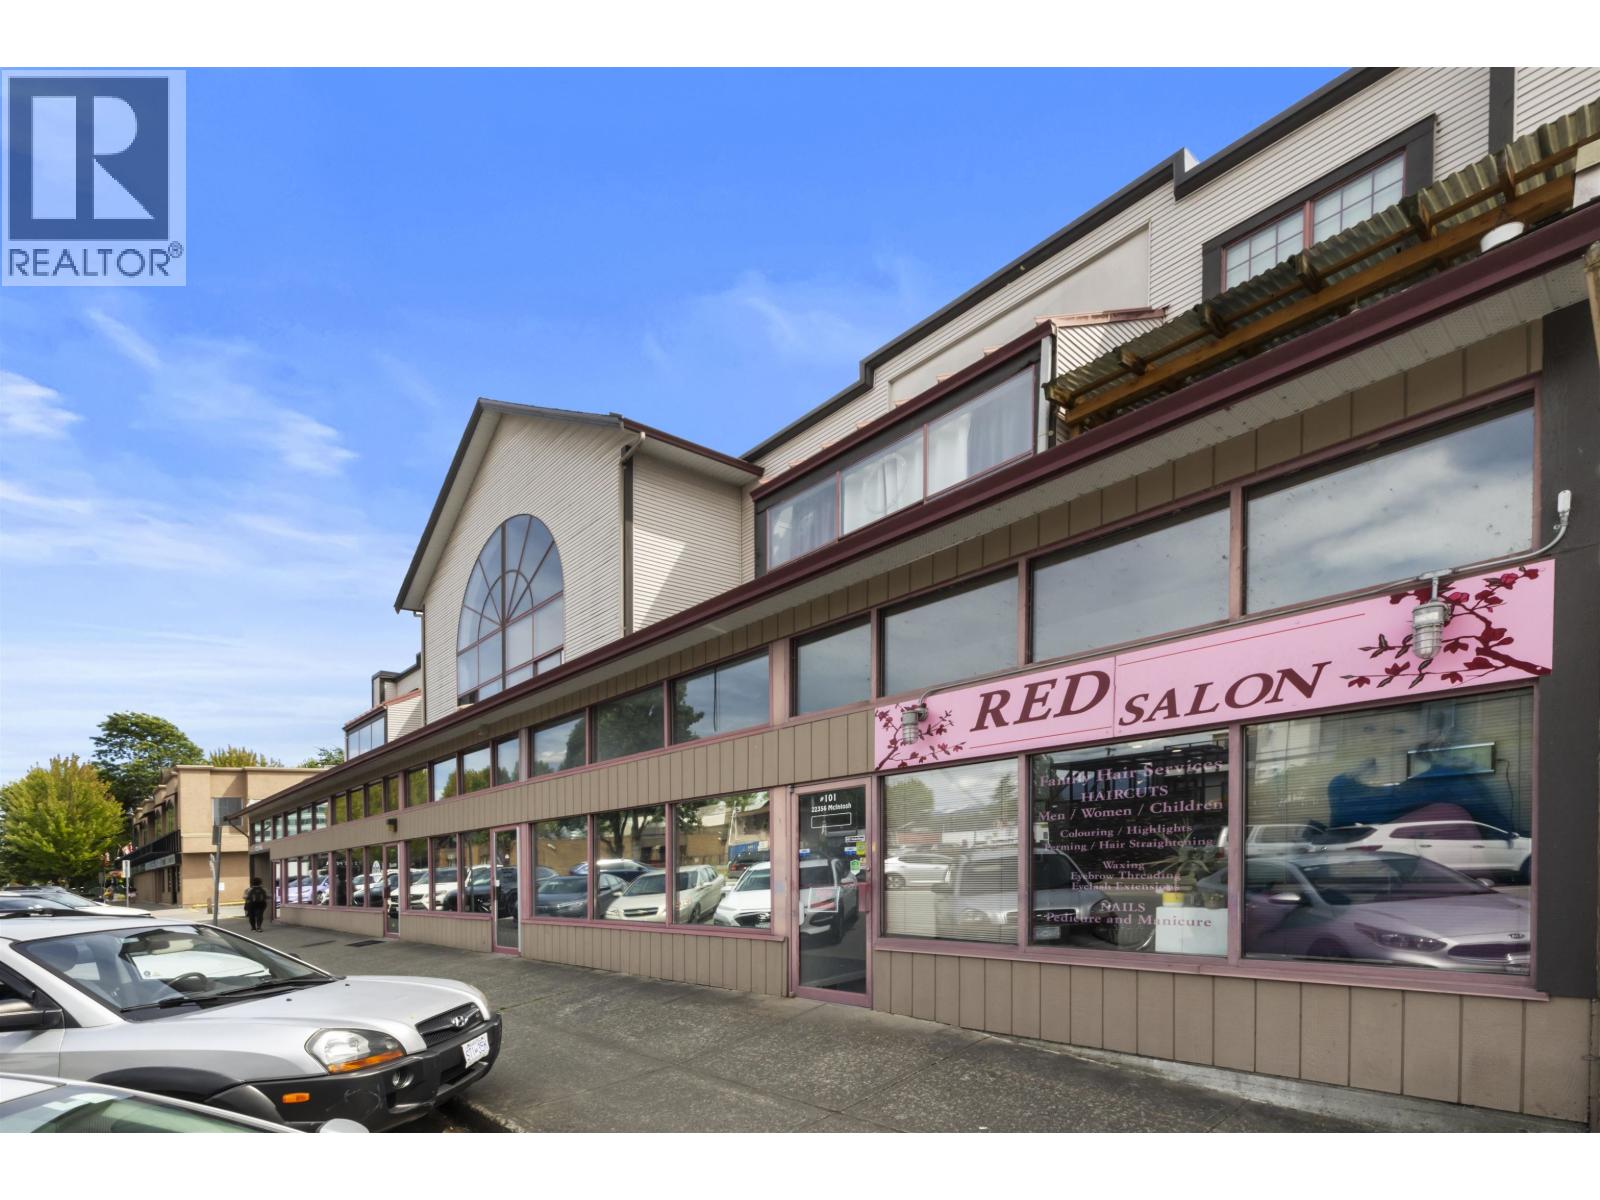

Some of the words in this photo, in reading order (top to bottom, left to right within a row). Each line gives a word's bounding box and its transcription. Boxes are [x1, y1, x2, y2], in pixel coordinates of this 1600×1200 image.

[970, 670, 1111, 732] RED
[1119, 661, 1332, 726] SALON
[1096, 766, 1136, 783] Hair
[1143, 759, 1224, 778] Services
[1081, 785, 1169, 803] HAIRCUTS
[1039, 810, 1066, 822] Men
[1081, 807, 1133, 819] Women
[1149, 799, 1224, 814] Children
[1060, 828, 1114, 838] Colouring
[1126, 823, 1193, 836] Highlights
[1044, 842, 1088, 852] Perming
[1099, 840, 1126, 850] Hair
[1128, 836, 1215, 849] Straightening
[1102, 860, 1146, 870] Waxing
[1070, 871, 1114, 882] Eyebrow
[1118, 870, 1182, 881] Threading
[1100, 902, 1146, 913] NAILS
[1046, 912, 1101, 924] Pedicure
[1106, 914, 1132, 925] and
[1138, 914, 1212, 928] Manicure
